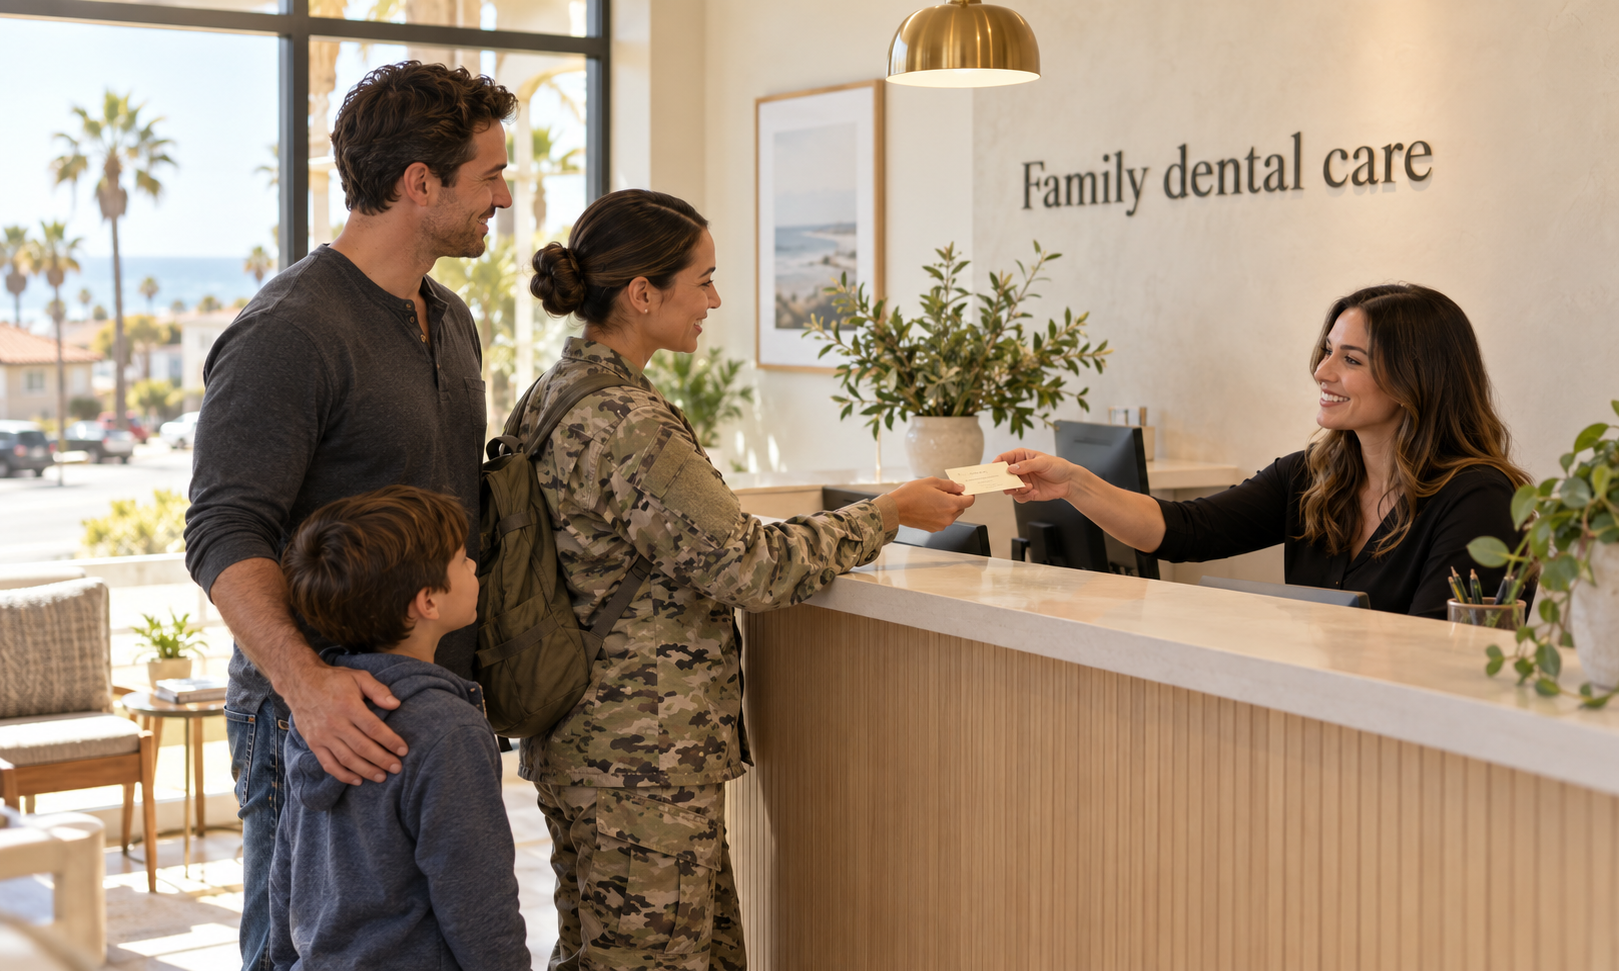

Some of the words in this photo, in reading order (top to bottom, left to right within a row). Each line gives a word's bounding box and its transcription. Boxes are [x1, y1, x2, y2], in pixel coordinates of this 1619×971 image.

[1021, 150, 1149, 217] Family
[1163, 131, 1304, 200] dental
[1322, 139, 1433, 189] care
